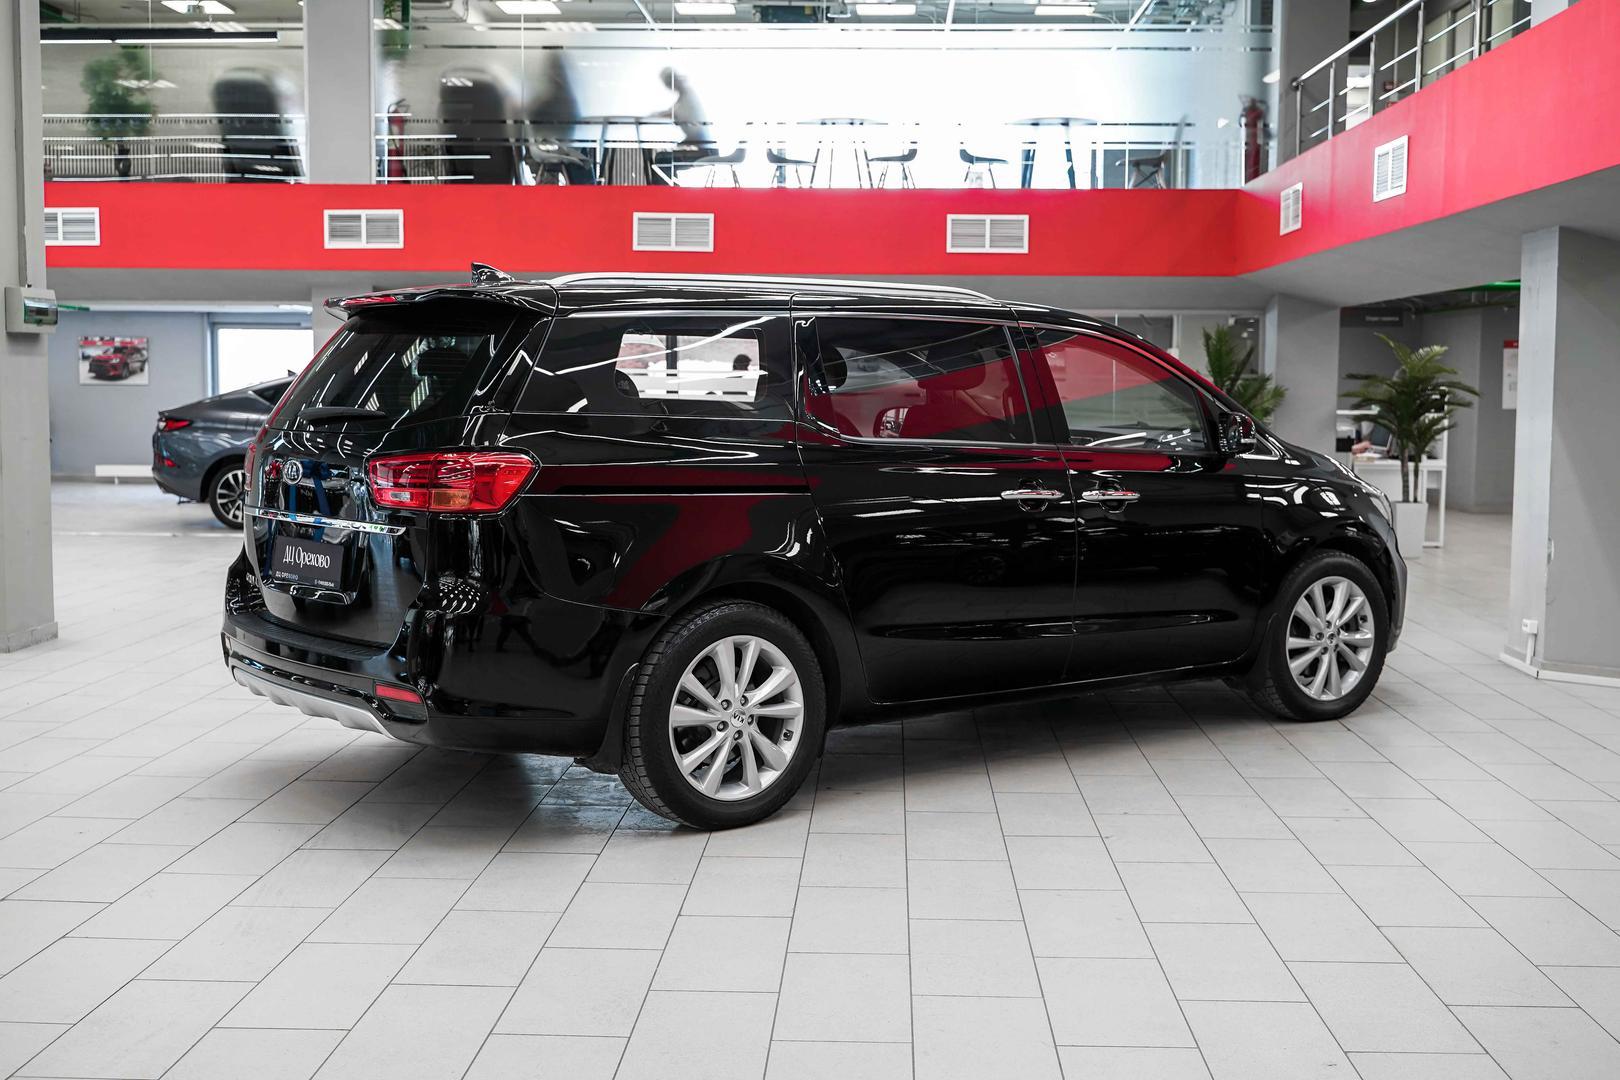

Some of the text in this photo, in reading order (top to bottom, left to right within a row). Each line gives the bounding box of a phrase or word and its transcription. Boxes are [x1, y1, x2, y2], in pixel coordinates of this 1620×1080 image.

[283, 545, 330, 568] ДЦ Орехово
[733, 712, 745, 723] KIA
